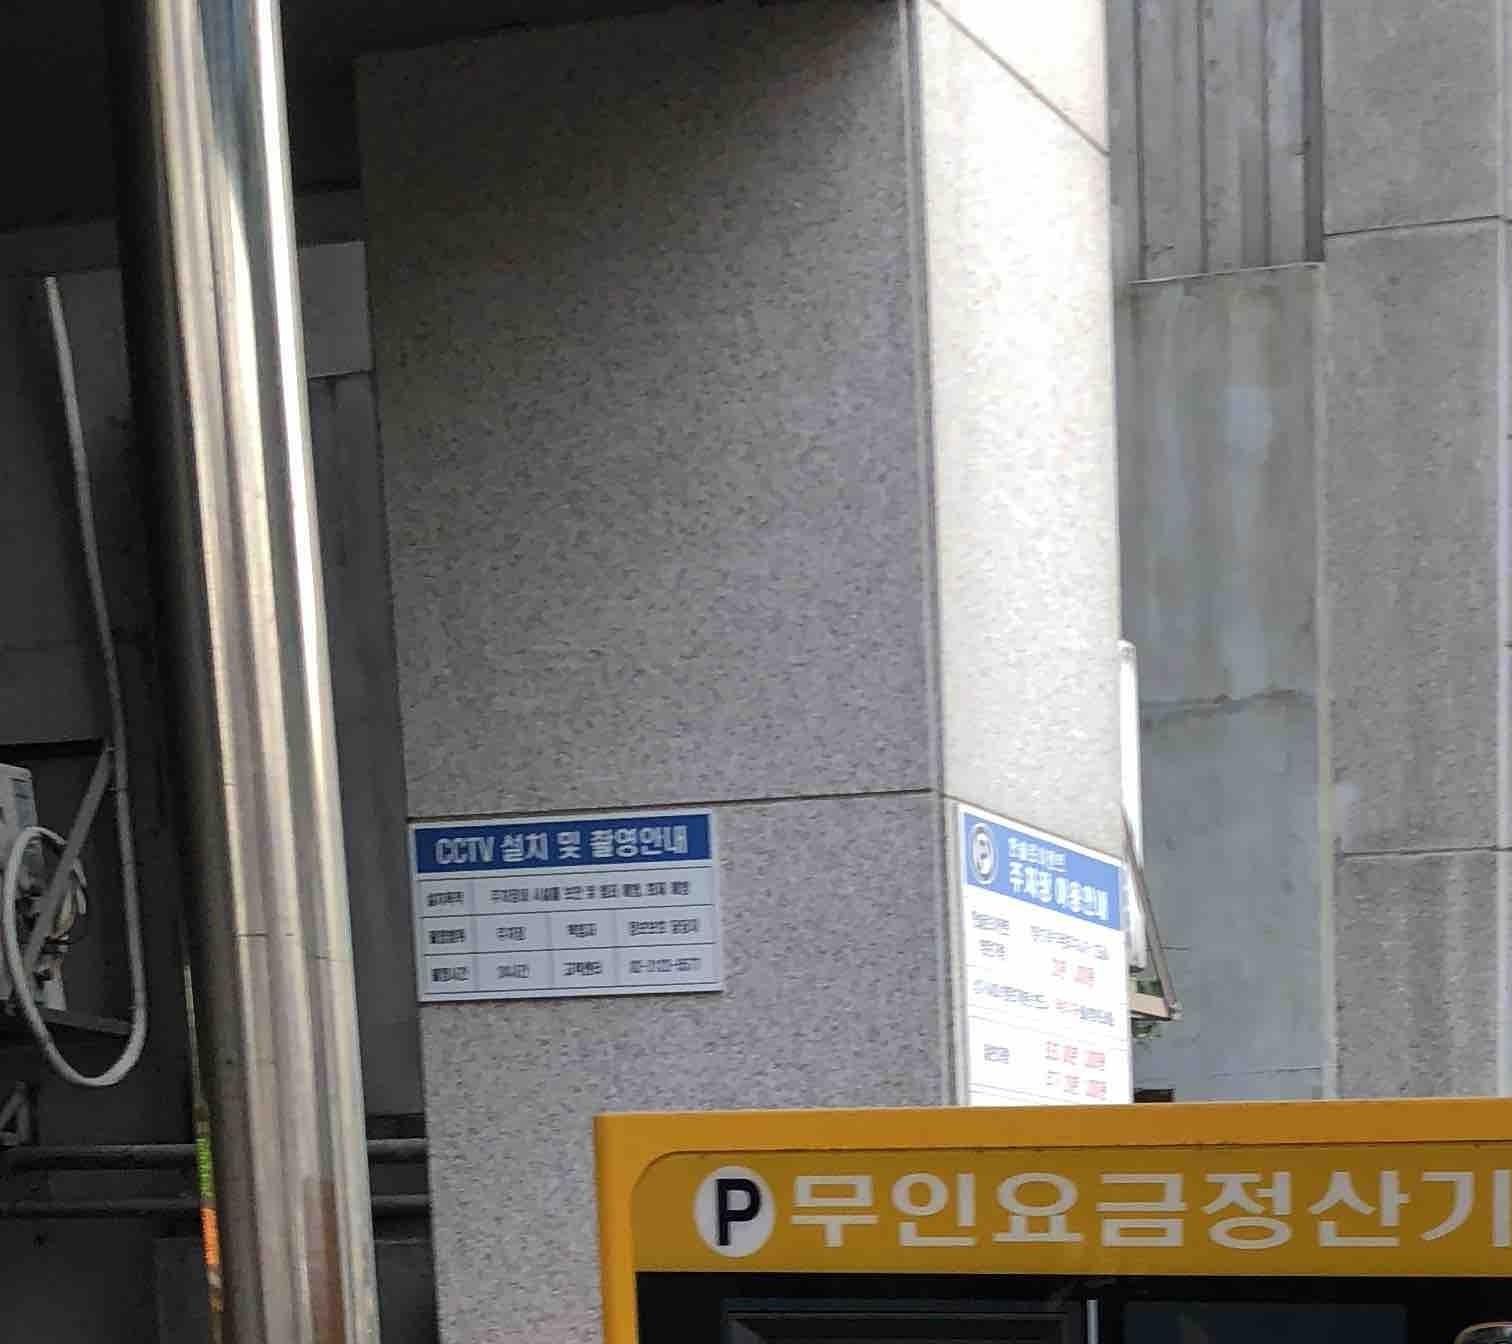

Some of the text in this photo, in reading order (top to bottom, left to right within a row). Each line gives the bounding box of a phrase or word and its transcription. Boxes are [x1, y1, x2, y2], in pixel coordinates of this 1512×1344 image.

[434, 836, 495, 865] CCTV
[501, 833, 548, 862] 설치
[557, 831, 582, 859] 및
[712, 1177, 761, 1248] P
